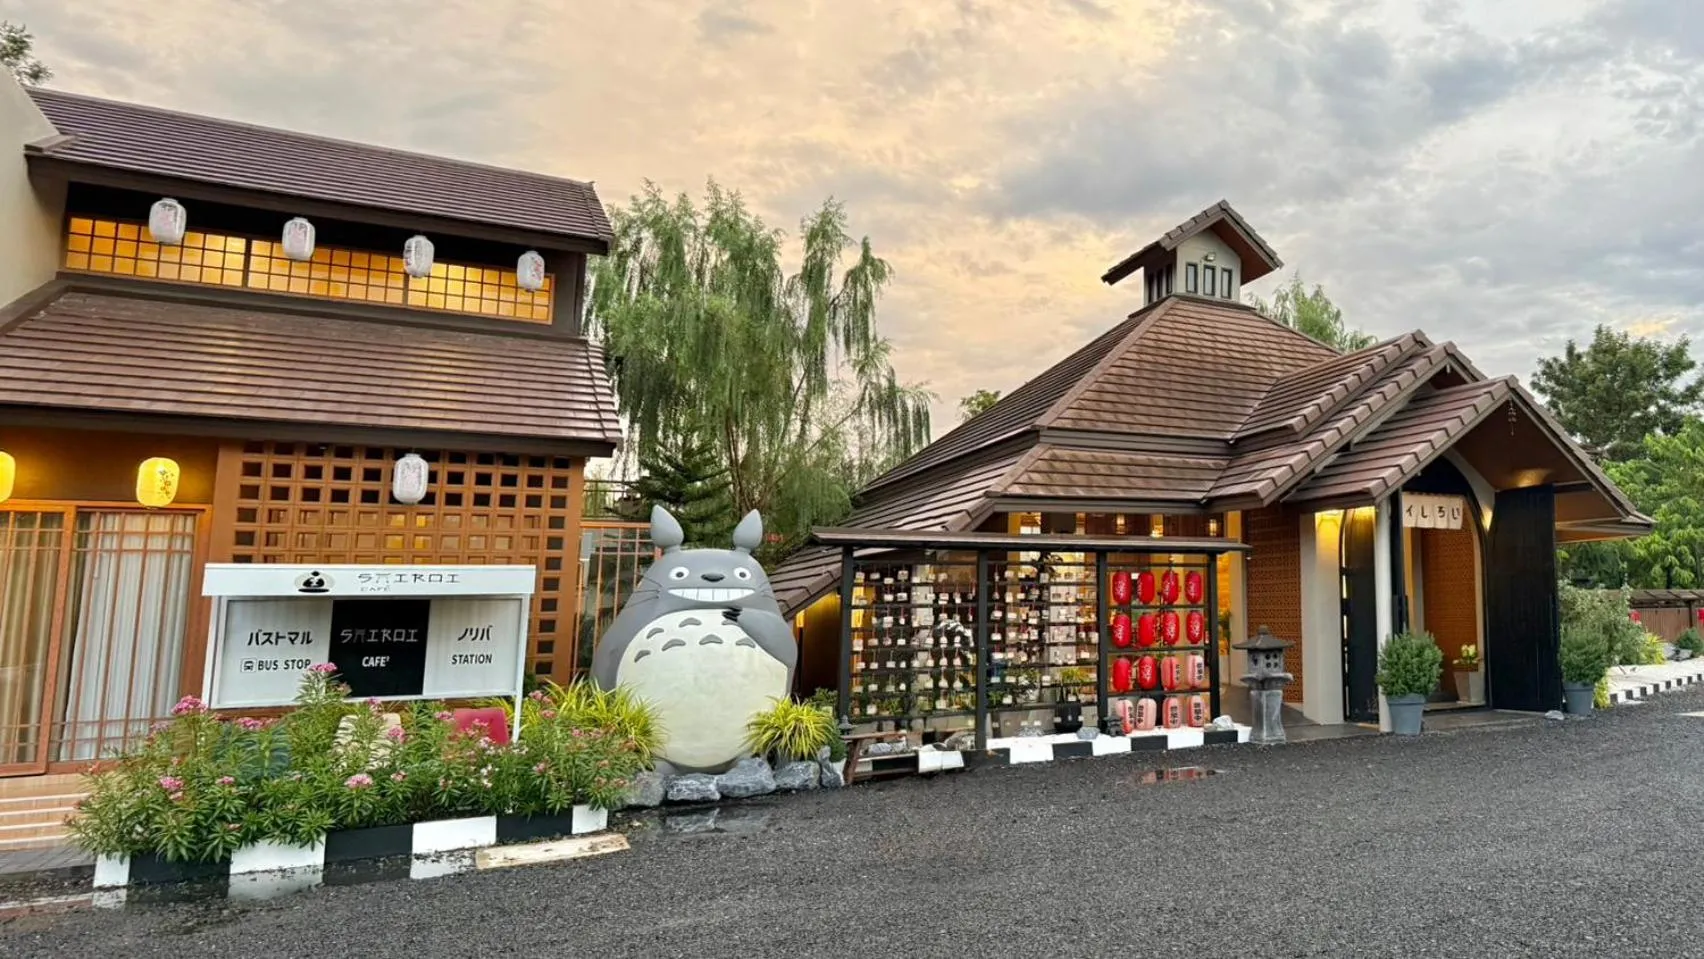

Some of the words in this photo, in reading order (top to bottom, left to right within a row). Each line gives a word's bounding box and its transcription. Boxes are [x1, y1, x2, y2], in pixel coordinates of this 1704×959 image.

[248, 629, 314, 646] バストマル
[457, 625, 493, 642] ノリバ
[257, 659, 279, 671] BUS
[284, 658, 312, 669] STOP
[451, 653, 493, 665] STATION
